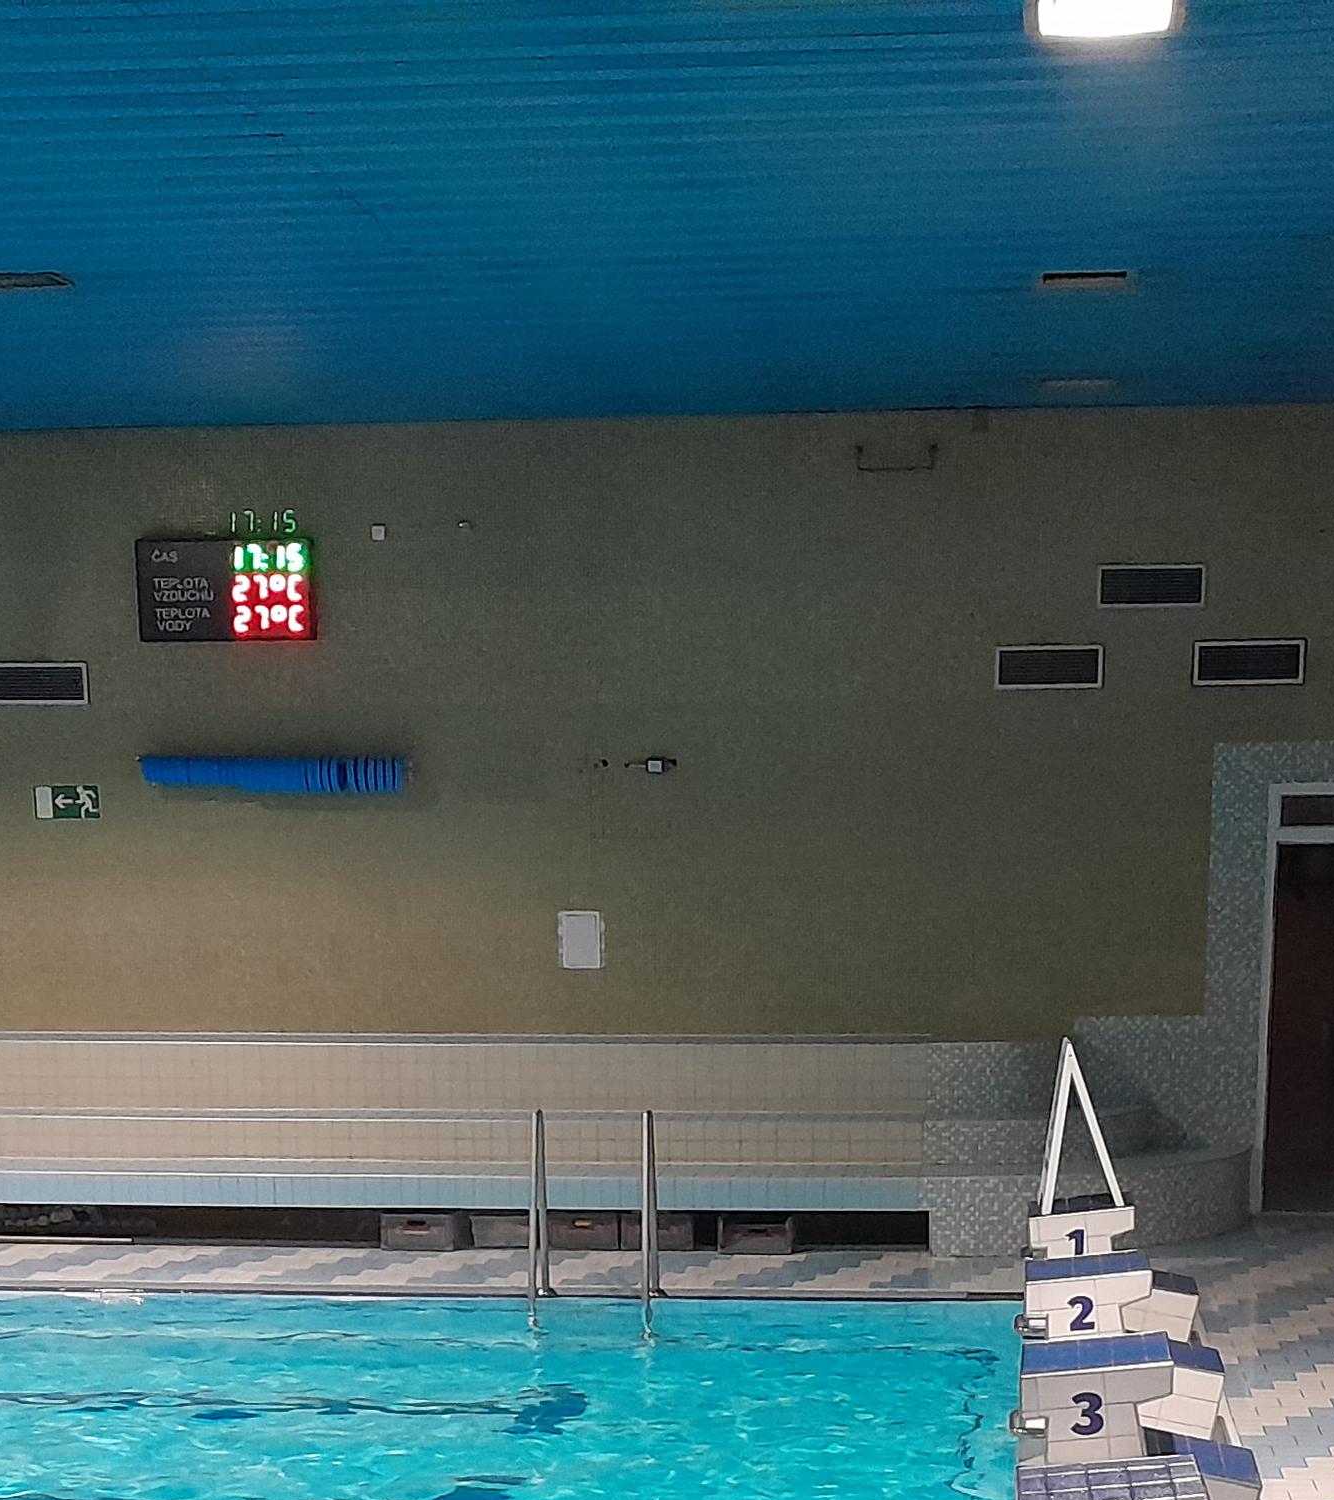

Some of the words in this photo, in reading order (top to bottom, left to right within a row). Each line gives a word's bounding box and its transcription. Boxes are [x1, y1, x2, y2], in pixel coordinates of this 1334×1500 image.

[229, 509, 297, 533] 17:15
[233, 542, 306, 571] 17:15
[155, 608, 211, 620] TEPLOTA
[157, 620, 193, 632] VODY
[1066, 1229, 1085, 1256] 1
[1067, 1296, 1095, 1331] 2
[1071, 1392, 1104, 1435] 3
